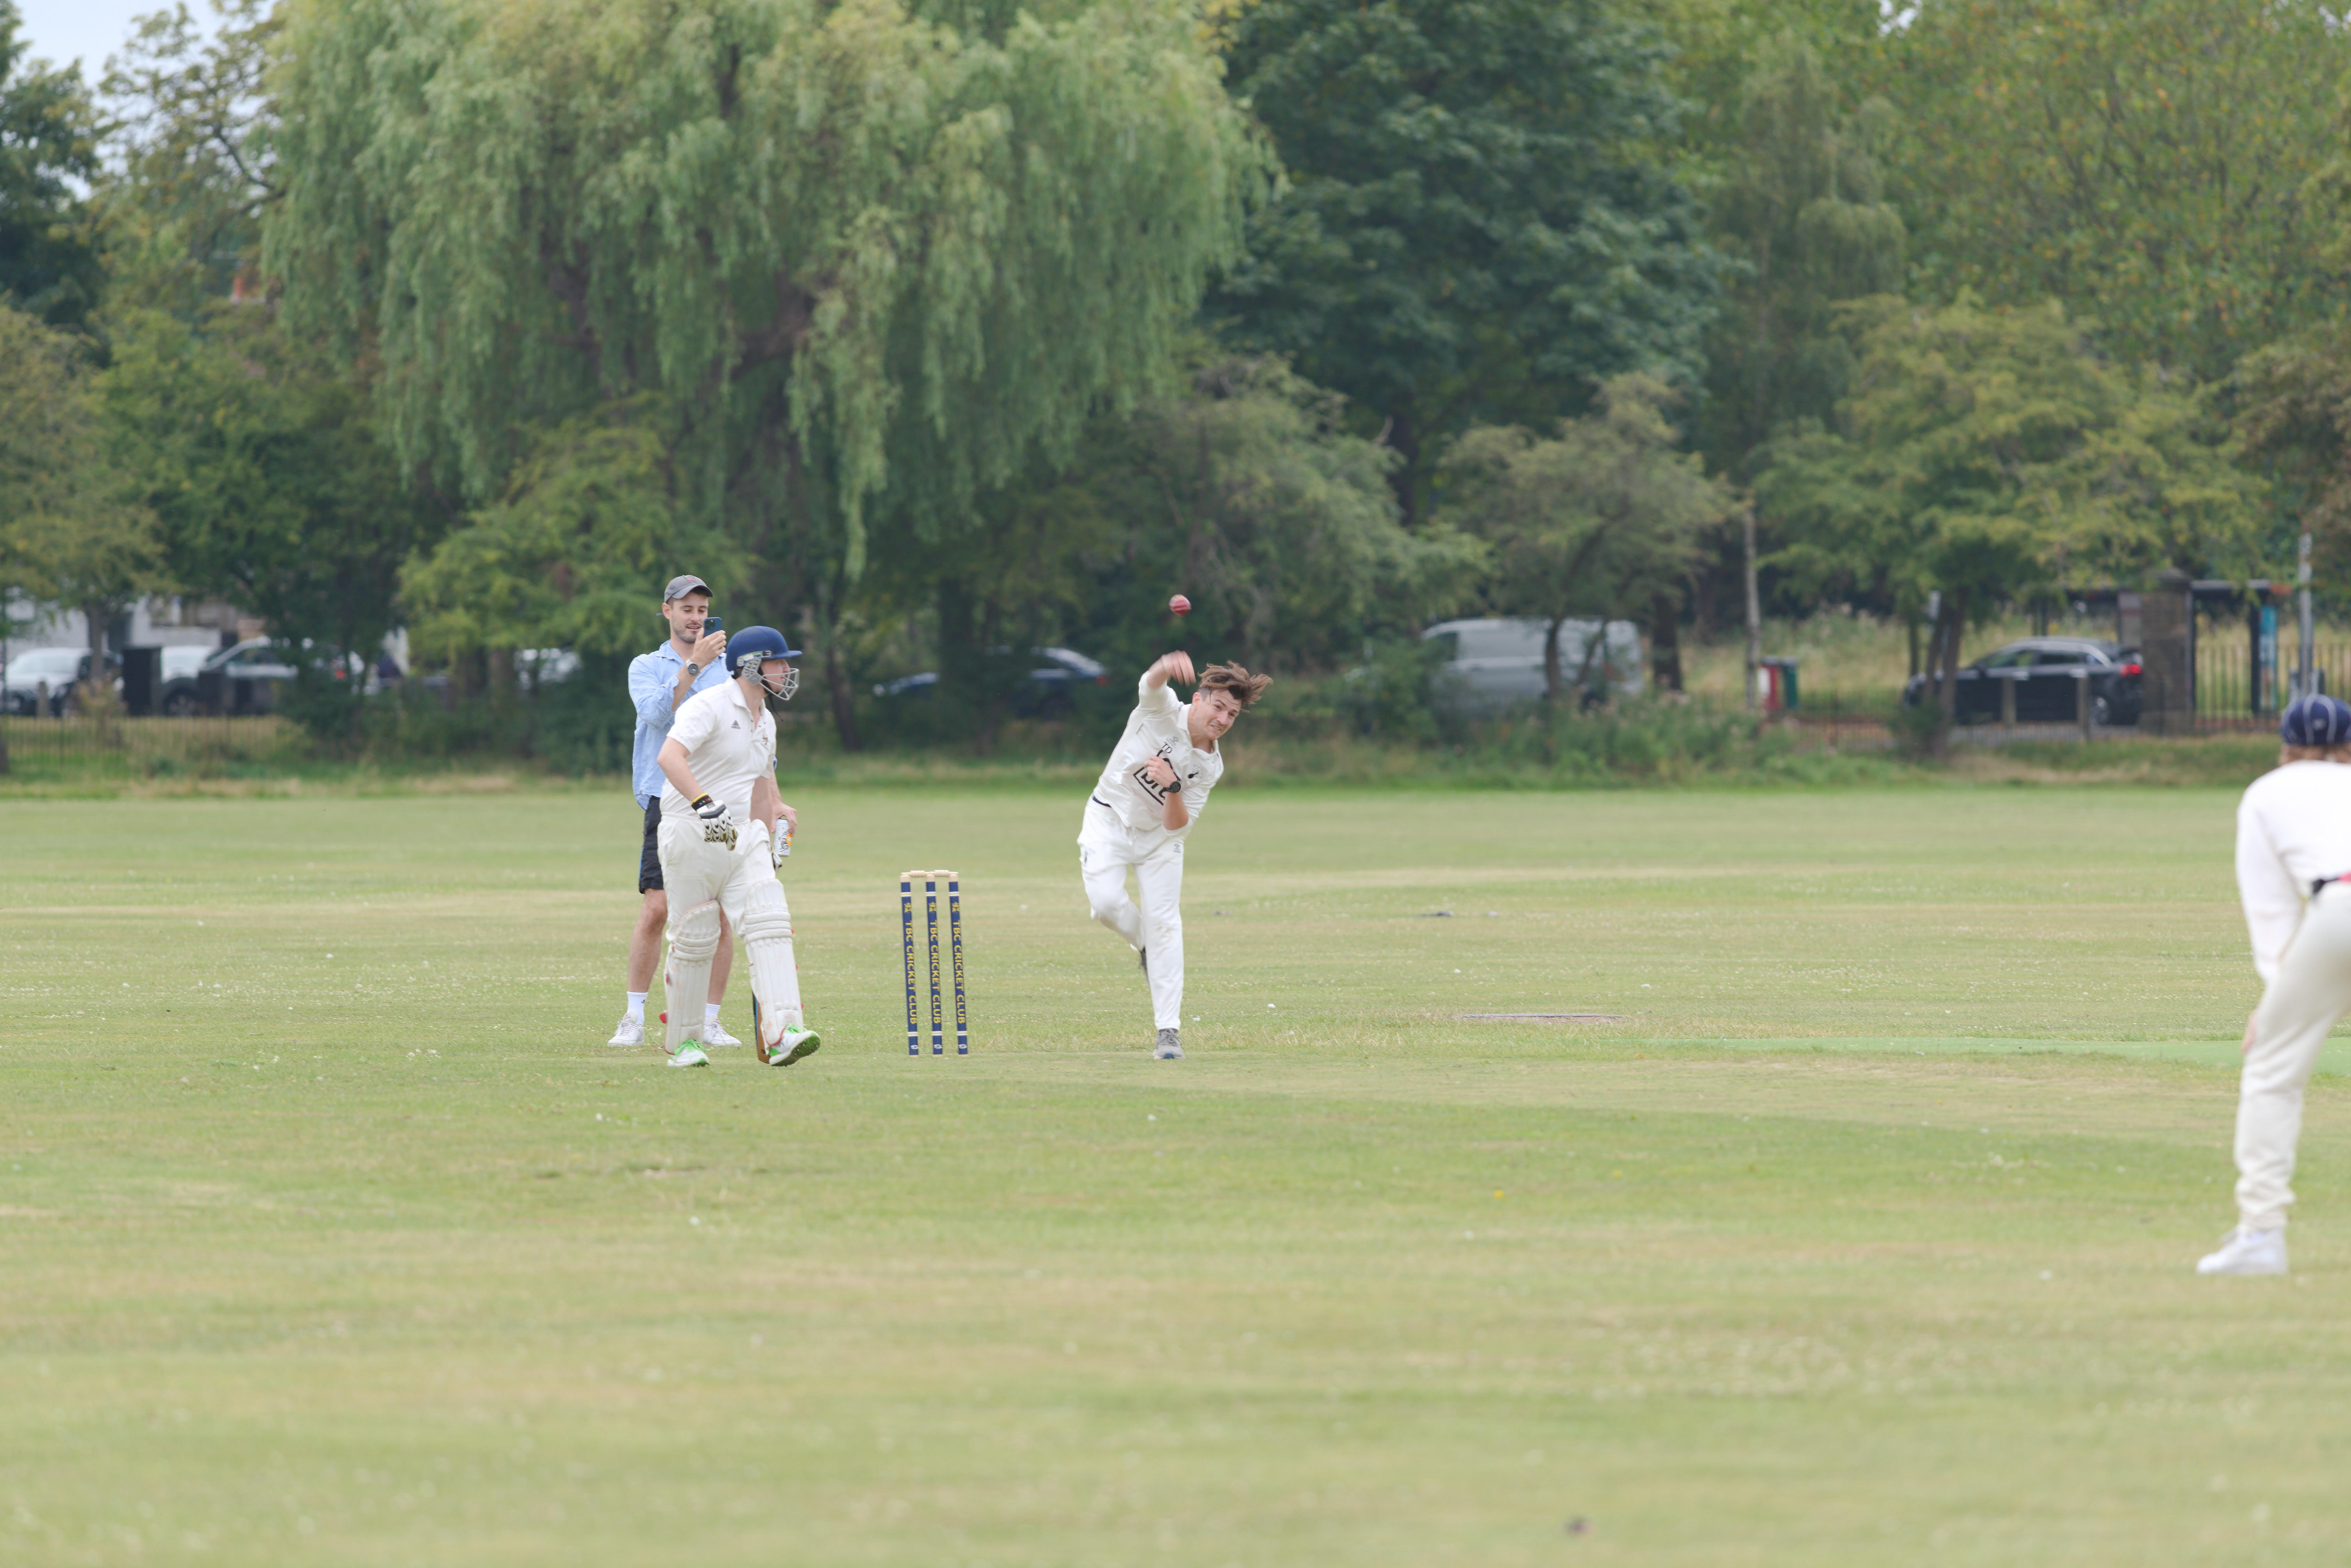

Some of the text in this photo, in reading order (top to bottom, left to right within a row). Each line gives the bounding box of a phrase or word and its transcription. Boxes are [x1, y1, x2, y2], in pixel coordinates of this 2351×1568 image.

[1162, 741, 1173, 754] TD
[905, 920, 917, 1024] TBC CRICKET CLUB
[930, 919, 941, 1023] TBC CRICKET CLUB
[953, 919, 966, 1023] TBC CRICKET CLUB
